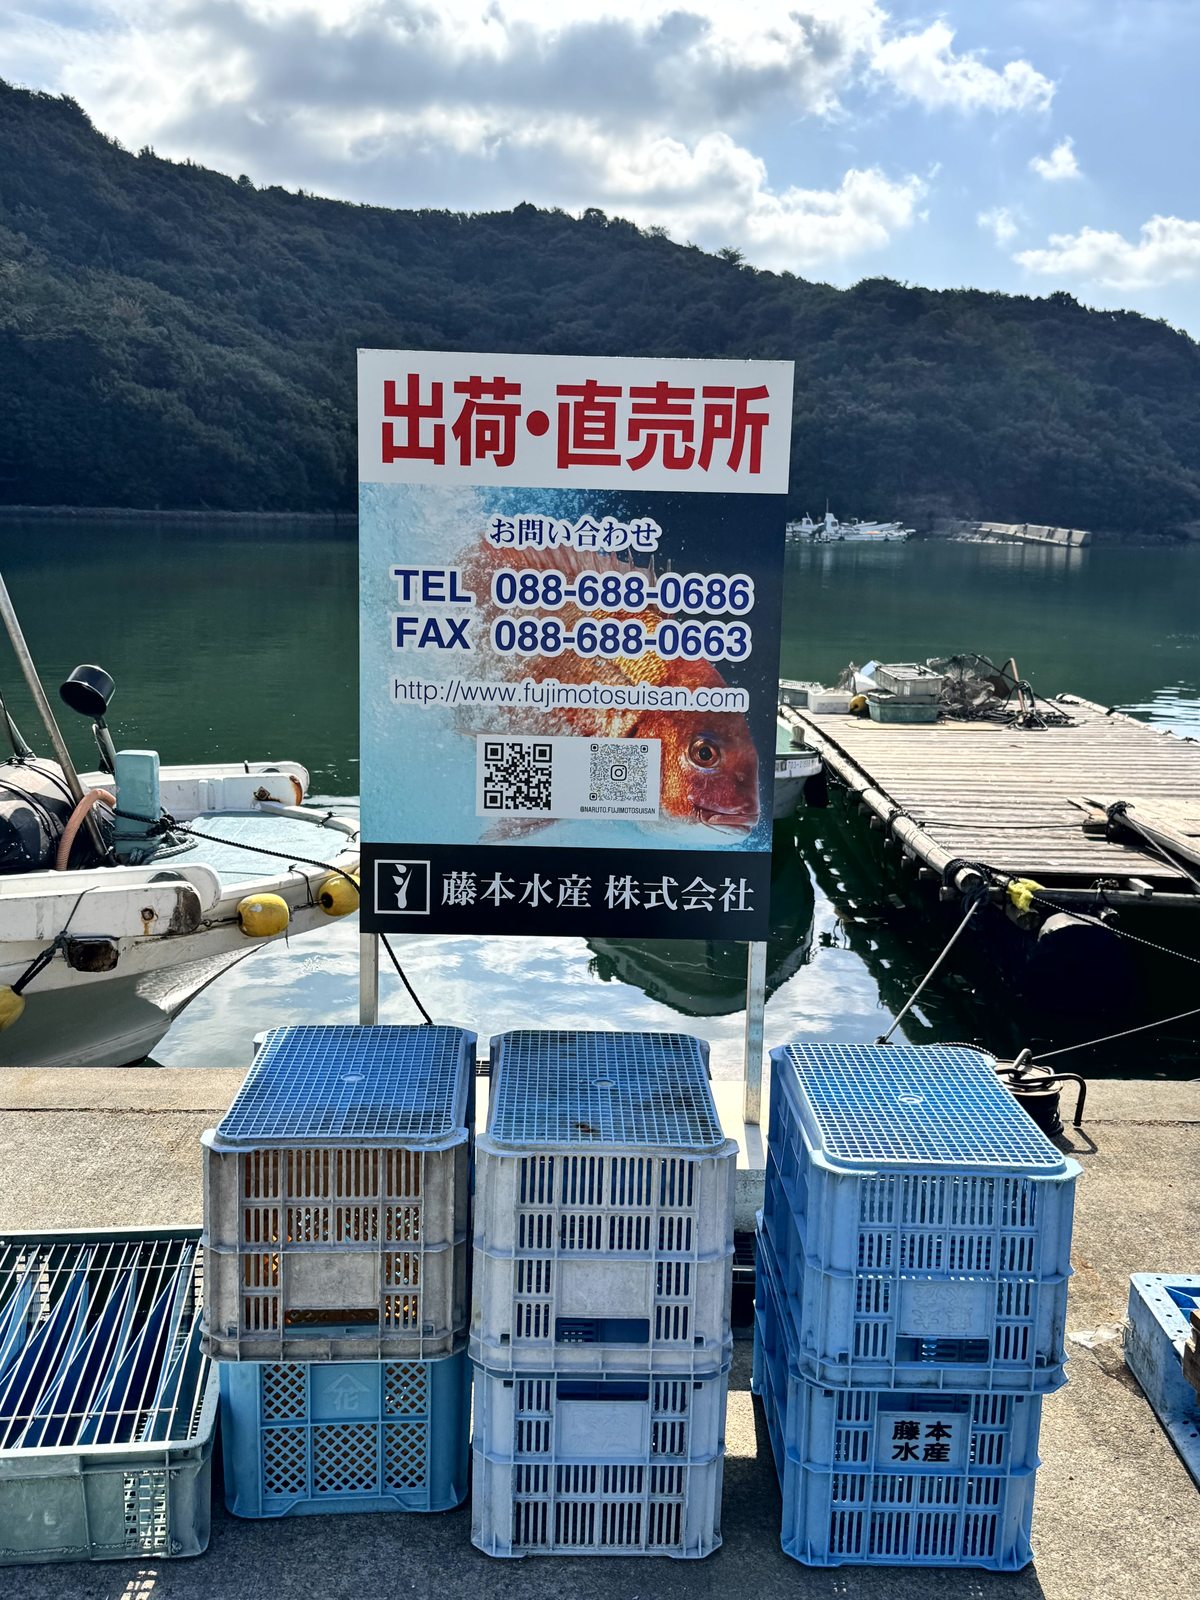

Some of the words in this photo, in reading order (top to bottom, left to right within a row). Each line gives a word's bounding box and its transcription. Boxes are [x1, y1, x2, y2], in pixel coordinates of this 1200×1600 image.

[381, 373, 770, 474] 出荷・直売所
[489, 517, 658, 549] お問い合わせ
[394, 569, 472, 603] TEL
[495, 572, 750, 611] 088-688-0686
[396, 616, 471, 650] FAX
[494, 619, 747, 657] 088-688-0663
[394, 678, 745, 708] http://www.fujimotosuisan.com
[579, 805, 656, 815] @NARUTO.FUJIMOTOSUISAN
[441, 870, 592, 909] 藤本水産
[603, 874, 755, 913] 株式会社
[891, 1420, 953, 1441] 藤本
[891, 1441, 951, 1462] 水産
